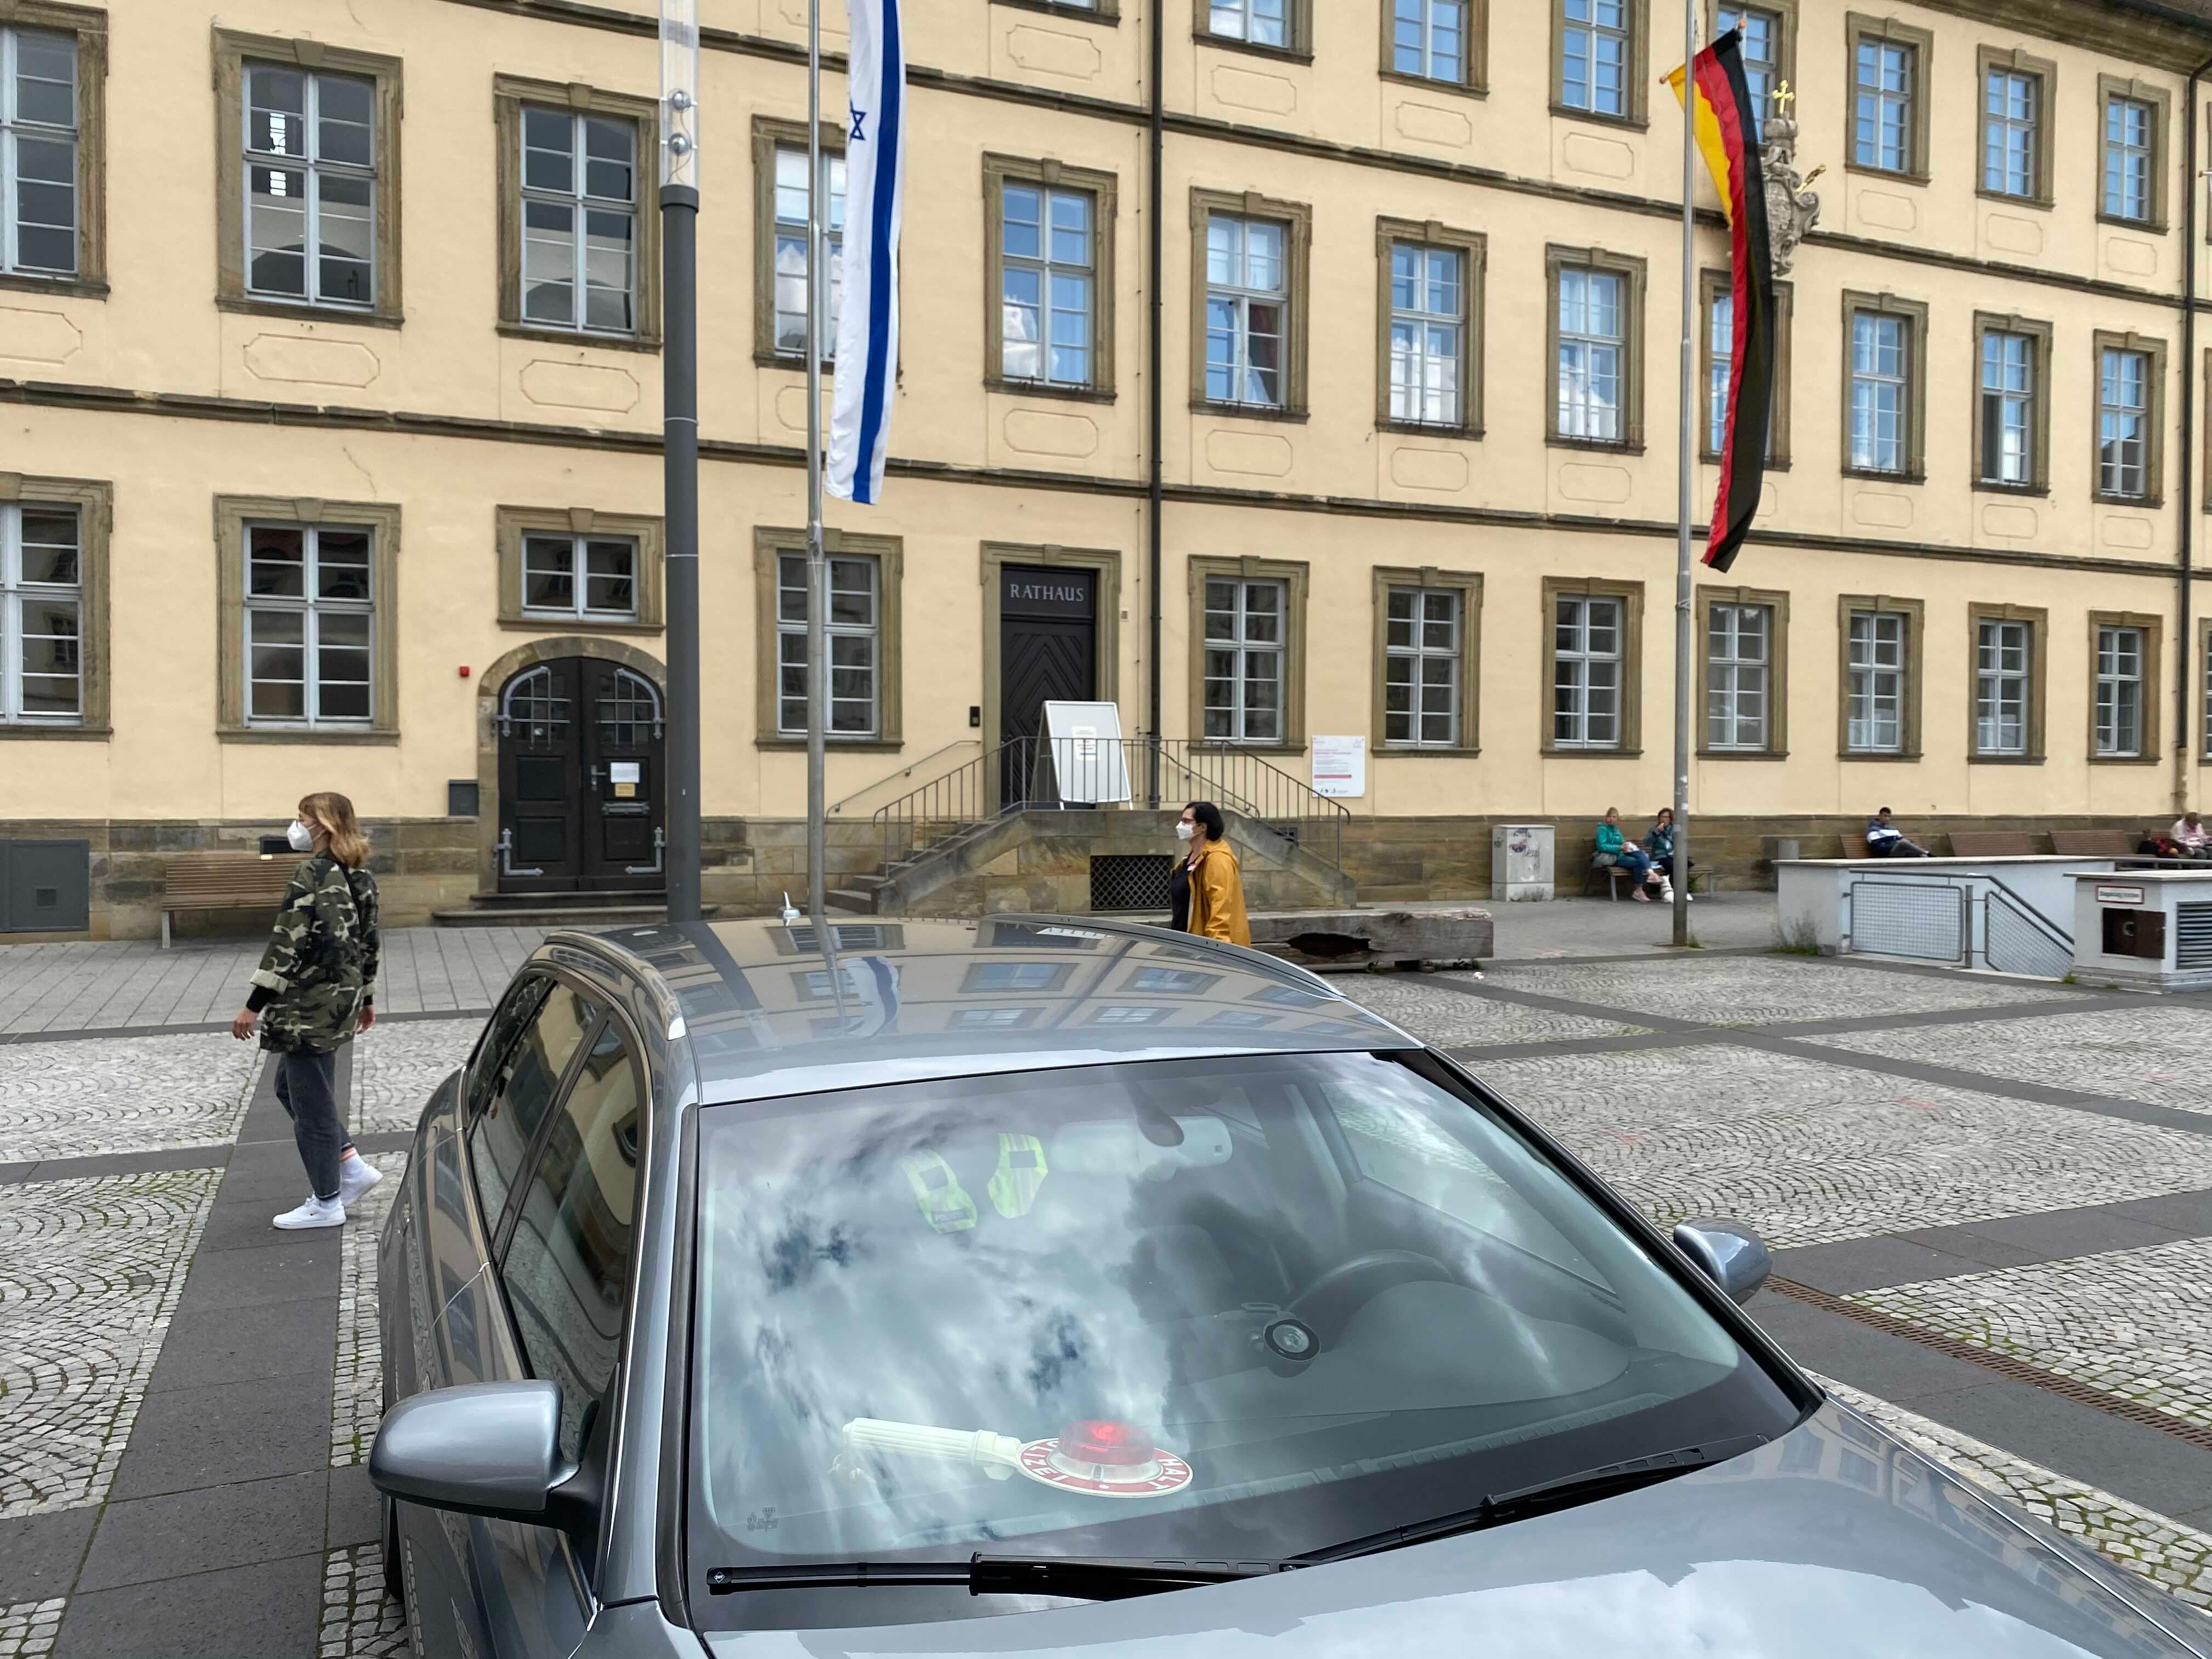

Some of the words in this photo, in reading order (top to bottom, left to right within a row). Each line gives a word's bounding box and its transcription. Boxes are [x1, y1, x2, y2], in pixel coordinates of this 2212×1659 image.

[1010, 584, 1084, 602] RATHAUS
[1023, 1440, 1070, 1481] OLIZEI
[1147, 1458, 1187, 1490] HALT
